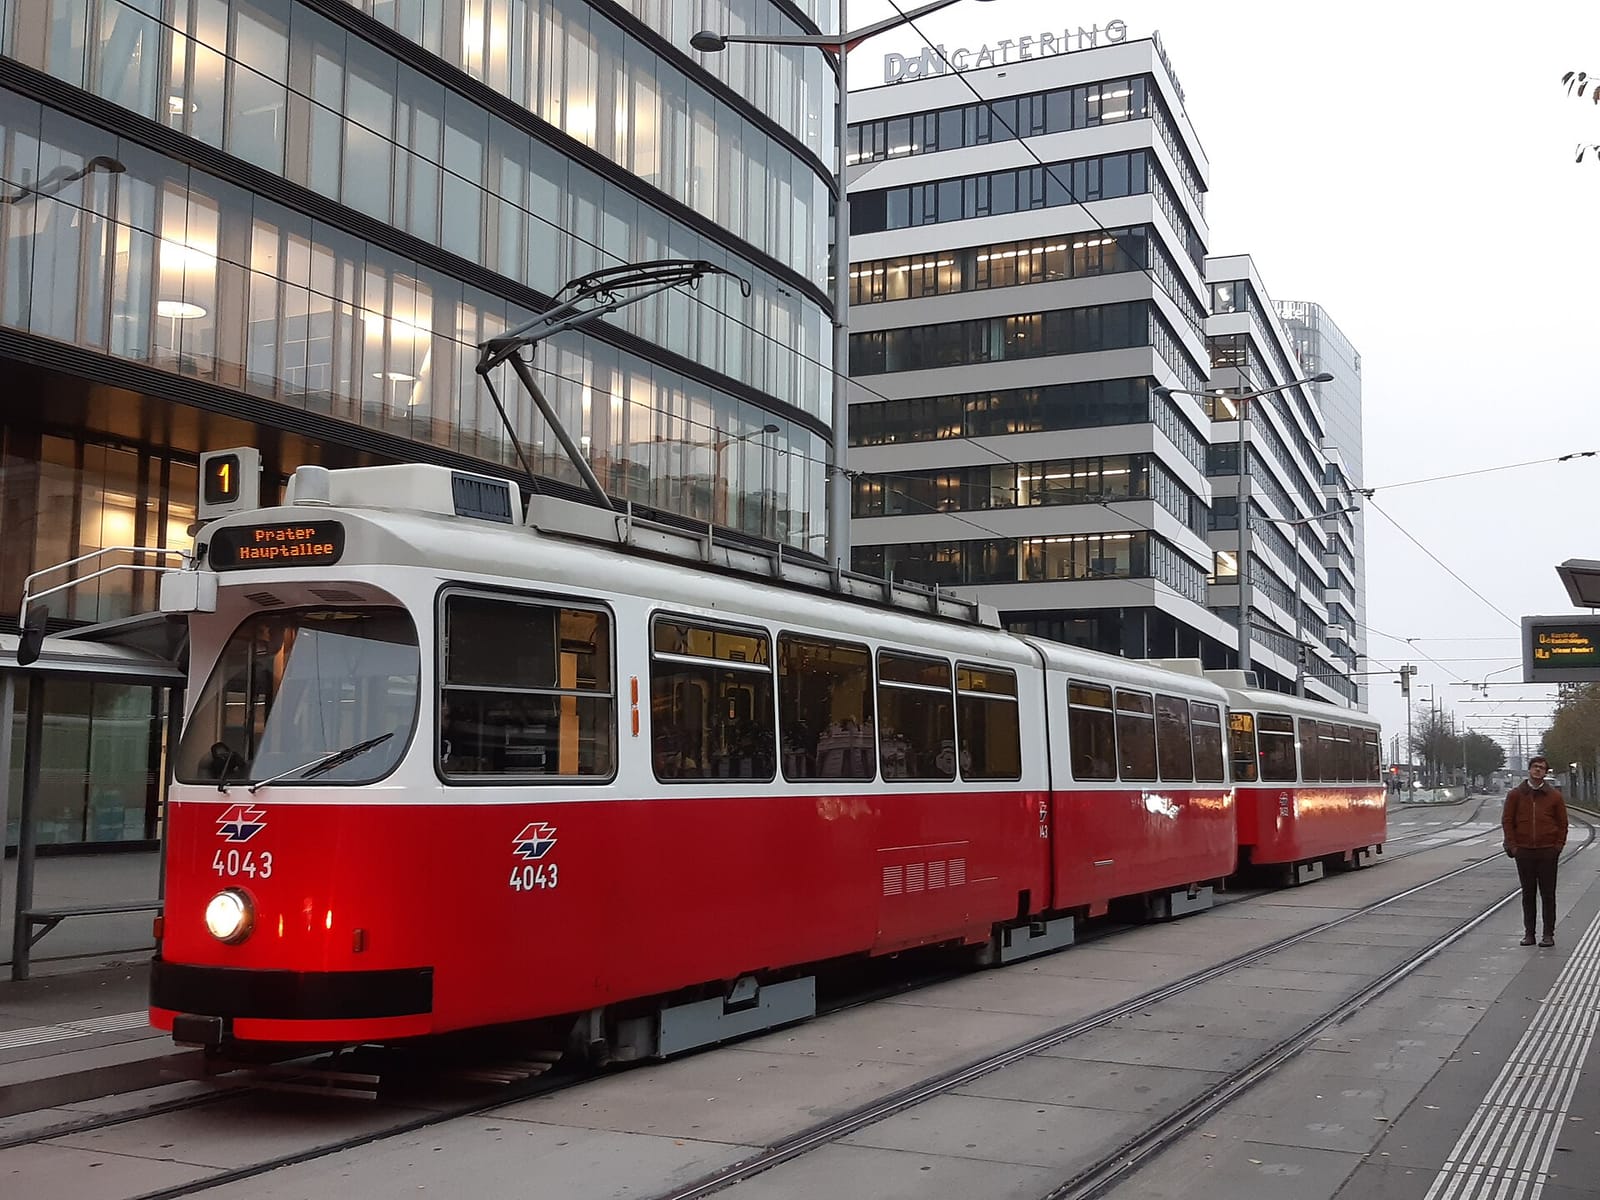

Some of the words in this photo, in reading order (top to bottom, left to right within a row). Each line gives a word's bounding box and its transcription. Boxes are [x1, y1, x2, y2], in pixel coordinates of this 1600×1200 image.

[951, 19, 1127, 71] CATERING
[217, 463, 230, 493] 1
[255, 528, 316, 542] Prater
[239, 543, 334, 560] Hauptallee
[212, 849, 273, 878] 4043
[509, 863, 558, 892] 4043
